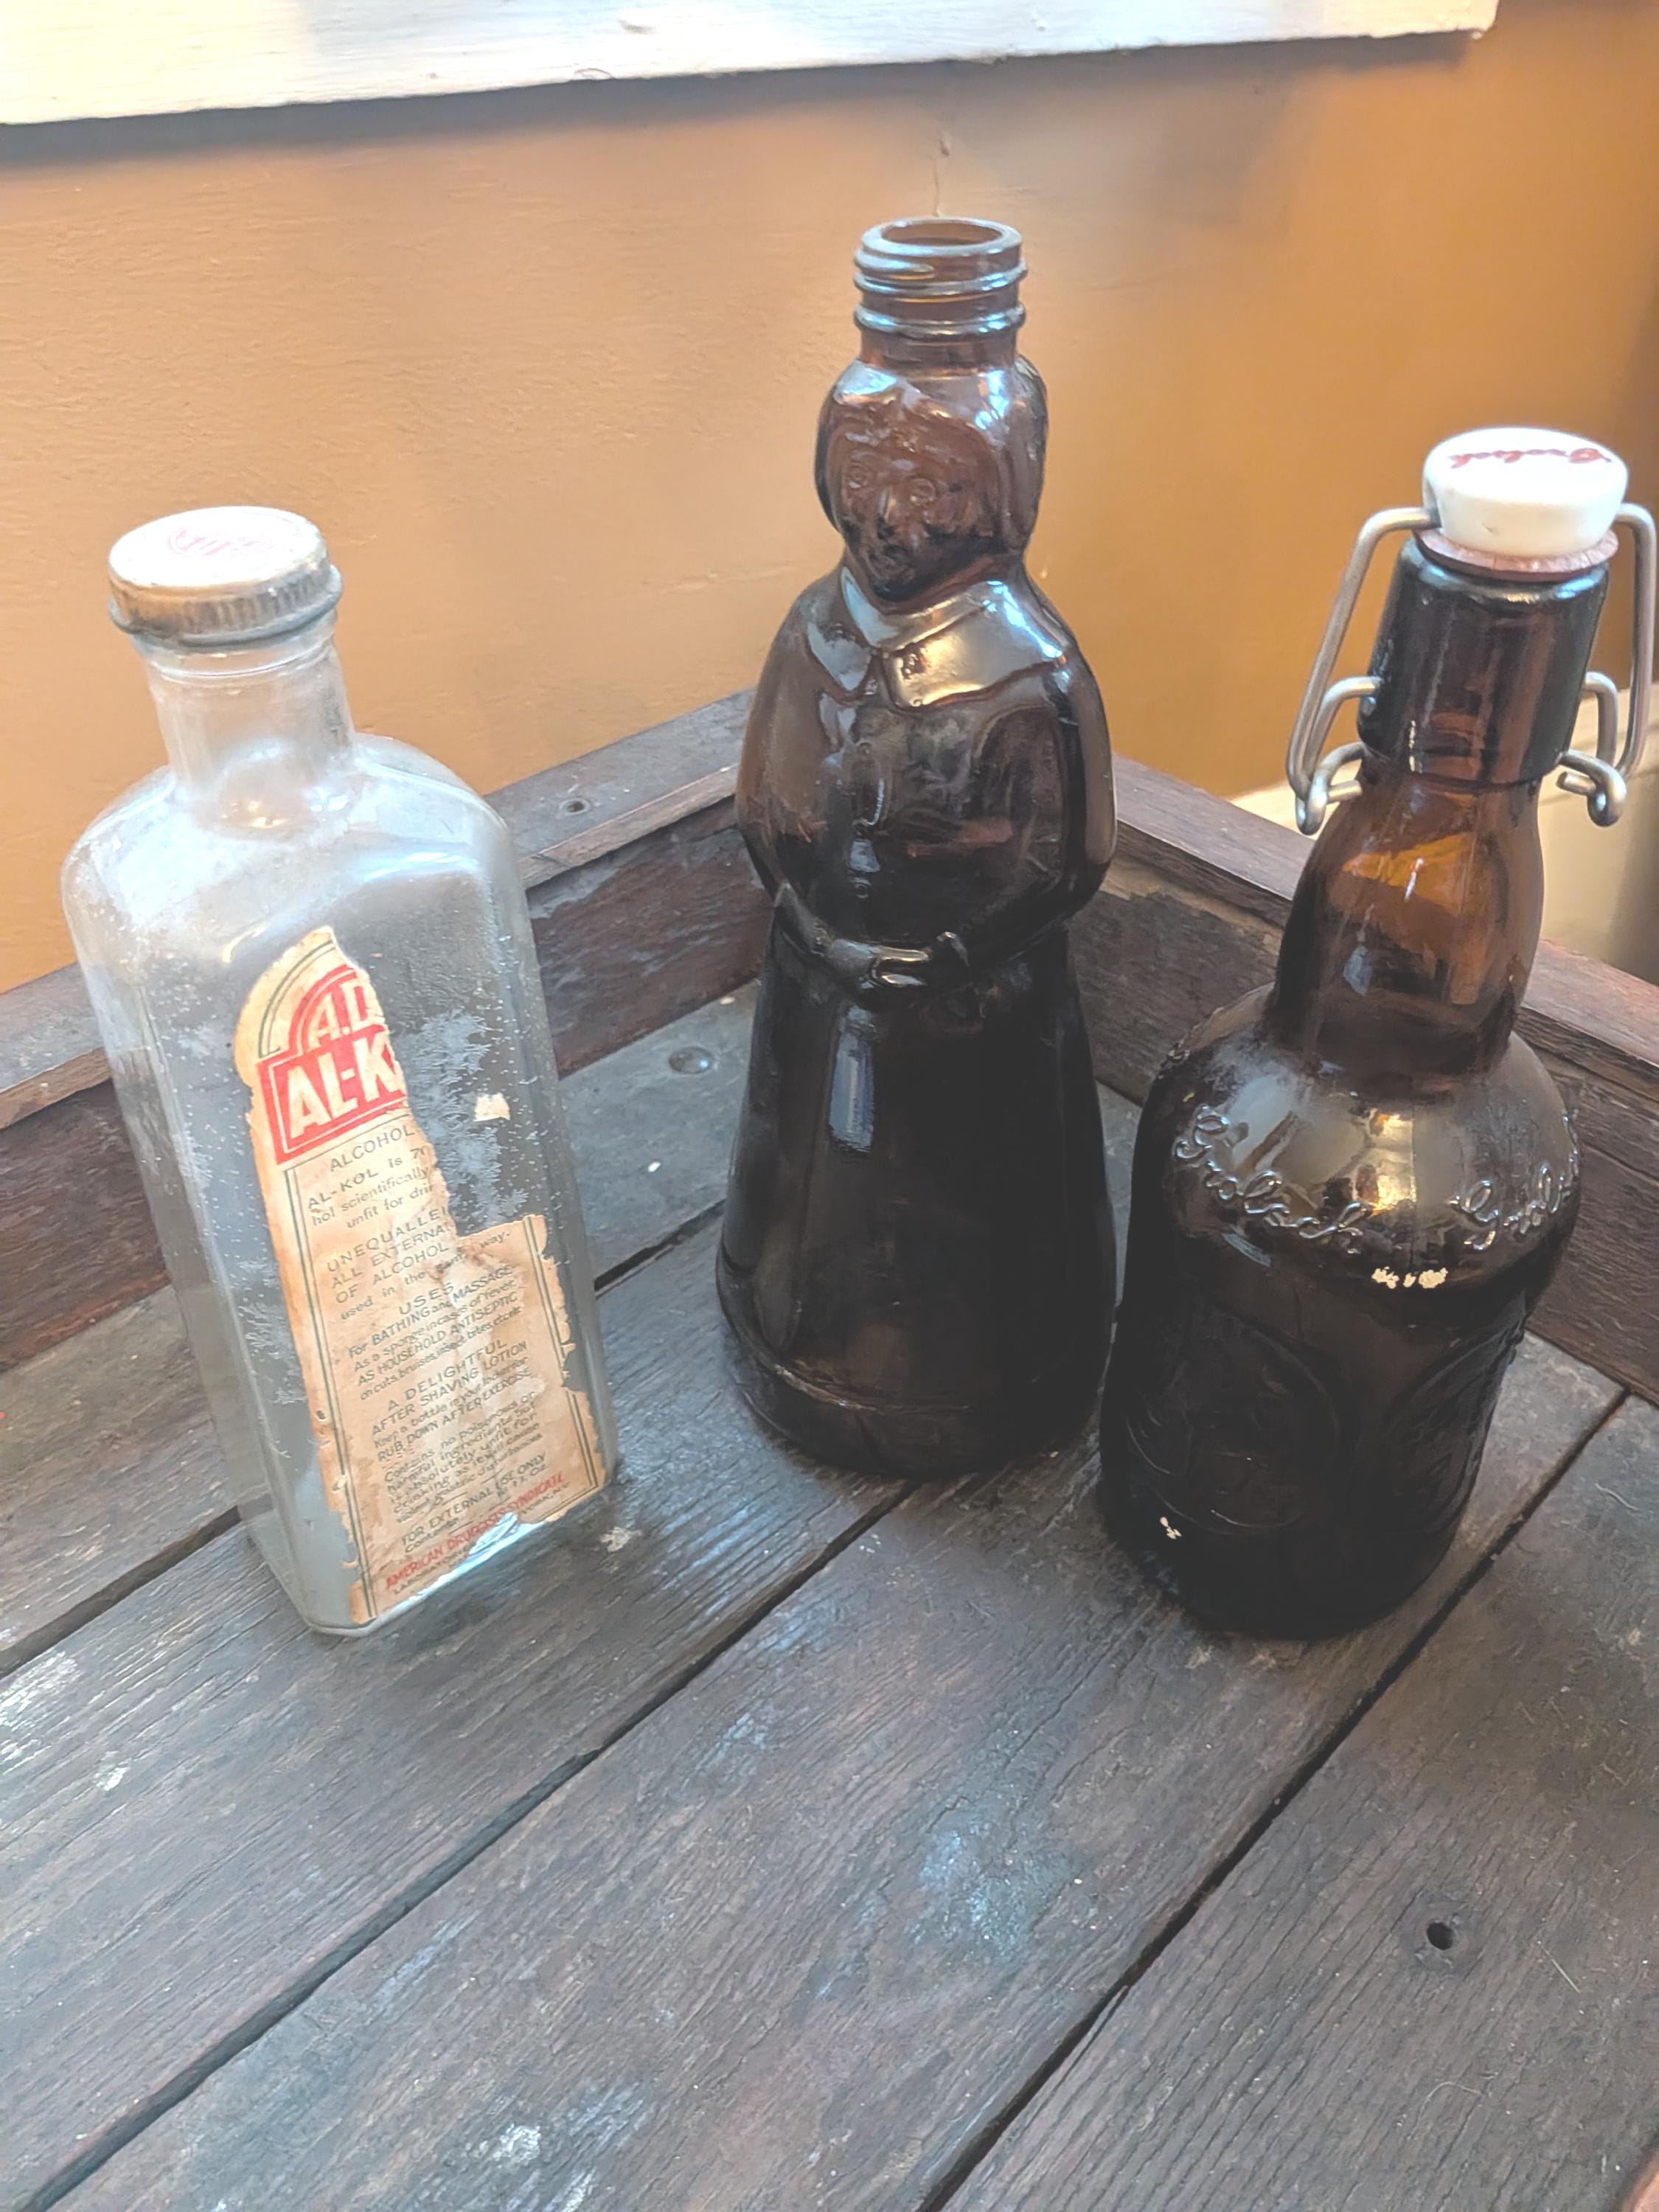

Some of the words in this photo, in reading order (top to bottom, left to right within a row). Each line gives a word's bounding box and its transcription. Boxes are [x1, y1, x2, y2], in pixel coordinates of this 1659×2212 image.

[306, 1164, 379, 1209] AL-KOL
[387, 1153, 403, 1169] is
[328, 1121, 414, 1172] ALCOHOL
[311, 1206, 335, 1227] hol
[341, 1161, 429, 1212] scientifically
[346, 1203, 379, 1229] unfit
[383, 1192, 404, 1211] for
[327, 1204, 446, 1273] UNEQUALLE
[335, 1283, 360, 1306] OF
[371, 1237, 449, 1285] ALCOHOL
[331, 1264, 362, 1289] ALL
[341, 1295, 373, 1321] used
[382, 1284, 394, 1297] in
[403, 1267, 425, 1287] the
[480, 1229, 510, 1250] way.
[398, 1279, 454, 1316] USES
[348, 1340, 368, 1358] For
[372, 1305, 431, 1346] BATHING
[453, 1263, 512, 1302] MASSAGE
[358, 1368, 375, 1386] AS
[378, 1329, 447, 1374] HOUSEHOLD
[450, 1290, 518, 1335] ANTISEPTIC
[353, 1356, 369, 1372] As
[382, 1326, 427, 1357] sponge
[386, 1396, 400, 1411] A
[404, 1336, 507, 1401] DELIGHTFUL
[371, 1402, 415, 1436] AFTER
[420, 1366, 479, 1408] SHAVING
[481, 1339, 527, 1372] LOTION
[377, 1439, 403, 1462] RUB
[406, 1419, 438, 1444] DOWN
[441, 1395, 482, 1425] AFTER
[482, 1366, 532, 1401] EXERCISE
[384, 1447, 435, 1484] Contains
[441, 1435, 456, 1449] no
[519, 1389, 535, 1405] or
[479, 1425, 511, 1452] unfit
[513, 1408, 538, 1430] for
[401, 1524, 424, 1546] FOR
[429, 1484, 492, 1528] EXTERNAL
[516, 1450, 547, 1475] ONLY
[386, 1544, 442, 1588] AMERICAN
